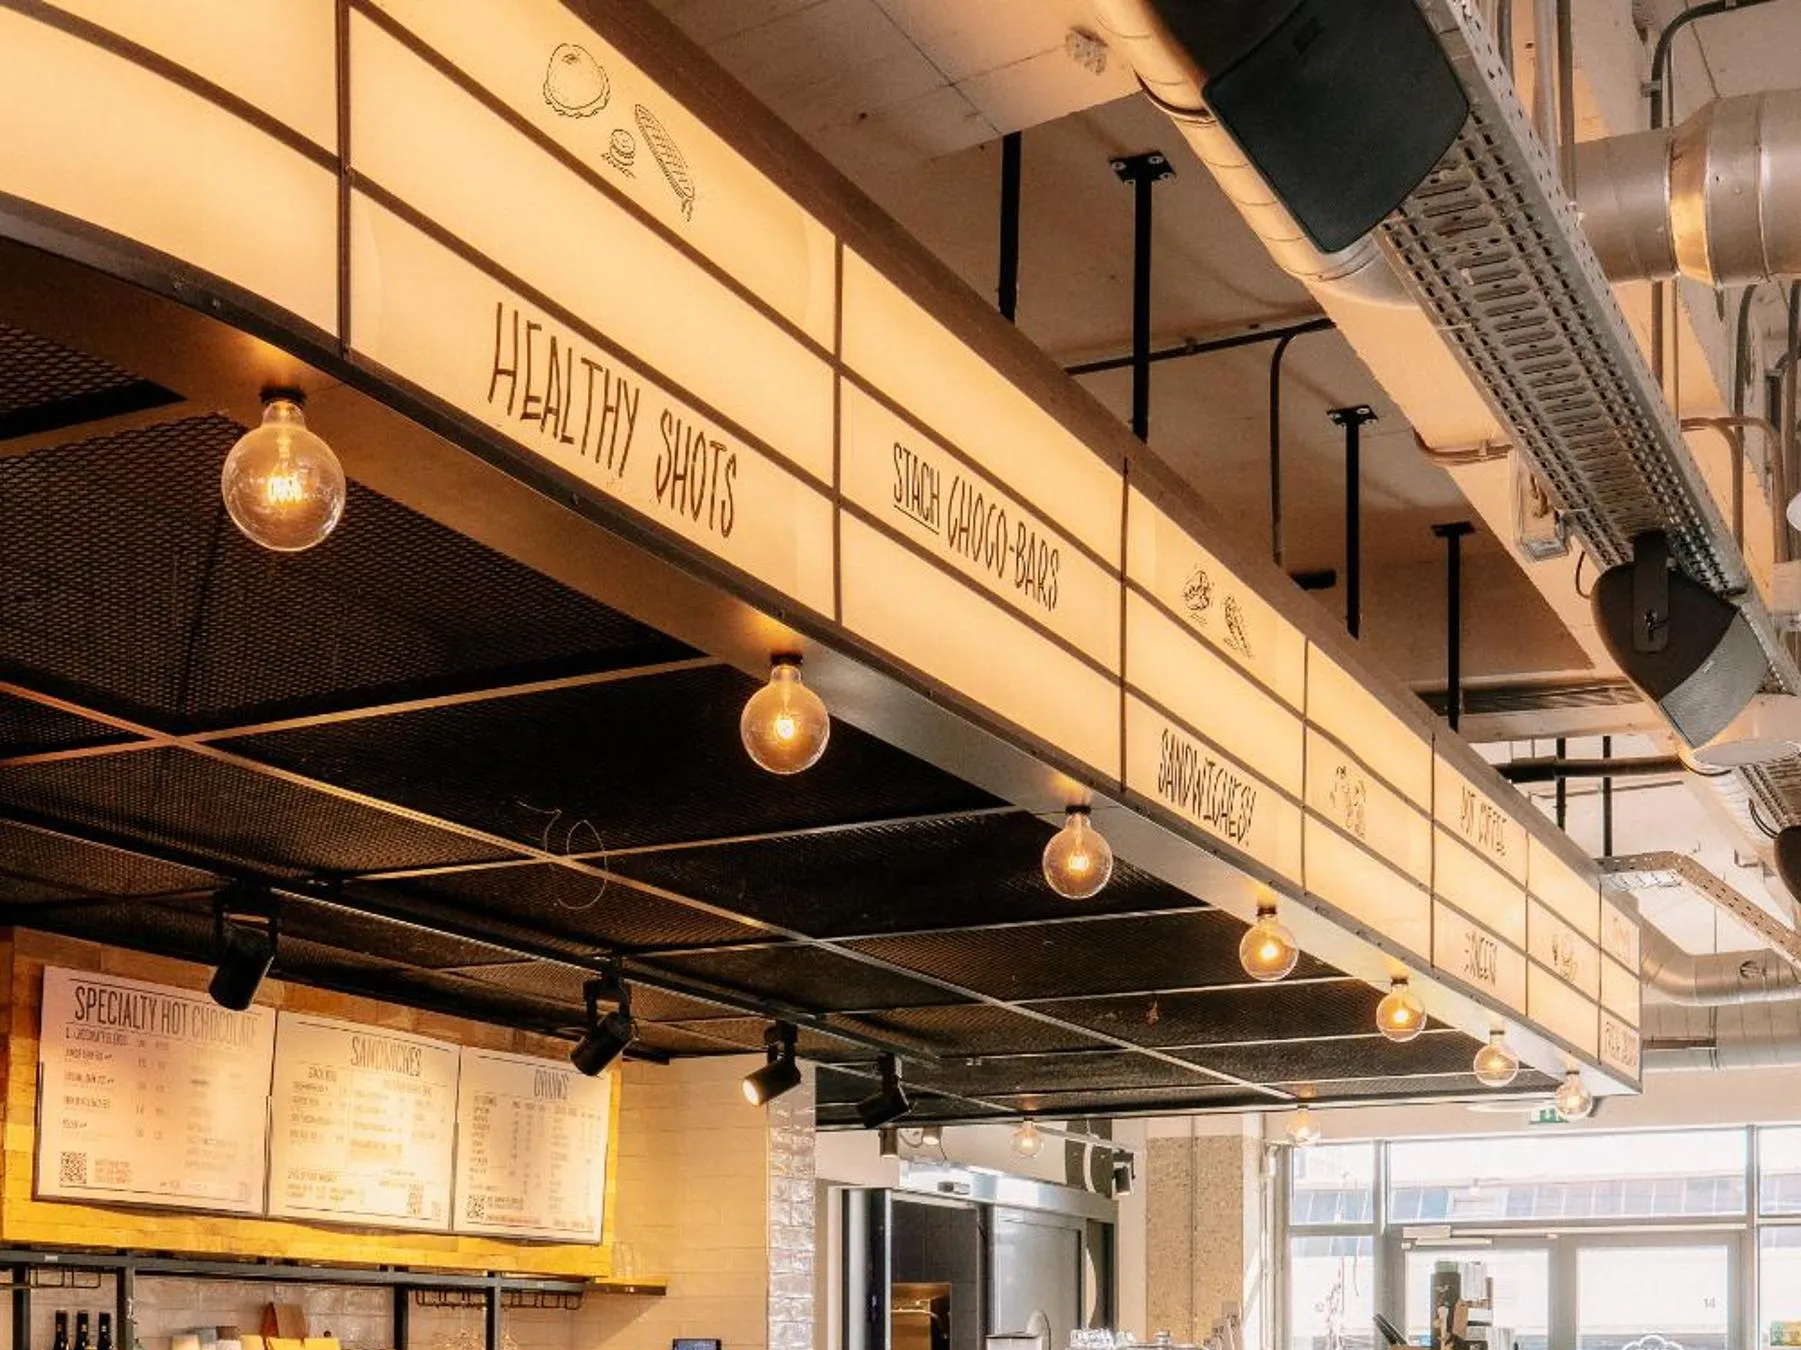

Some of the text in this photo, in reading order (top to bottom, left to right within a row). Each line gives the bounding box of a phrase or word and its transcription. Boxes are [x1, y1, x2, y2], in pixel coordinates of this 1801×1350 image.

[487, 301, 737, 538] HEALTHY SHOTS
[893, 442, 1060, 612] STACH CHOCO-BARS
[74, 985, 158, 1030] SPECIALTY
[161, 1000, 188, 1036] HOT
[350, 1035, 422, 1077] SANDWICHES
